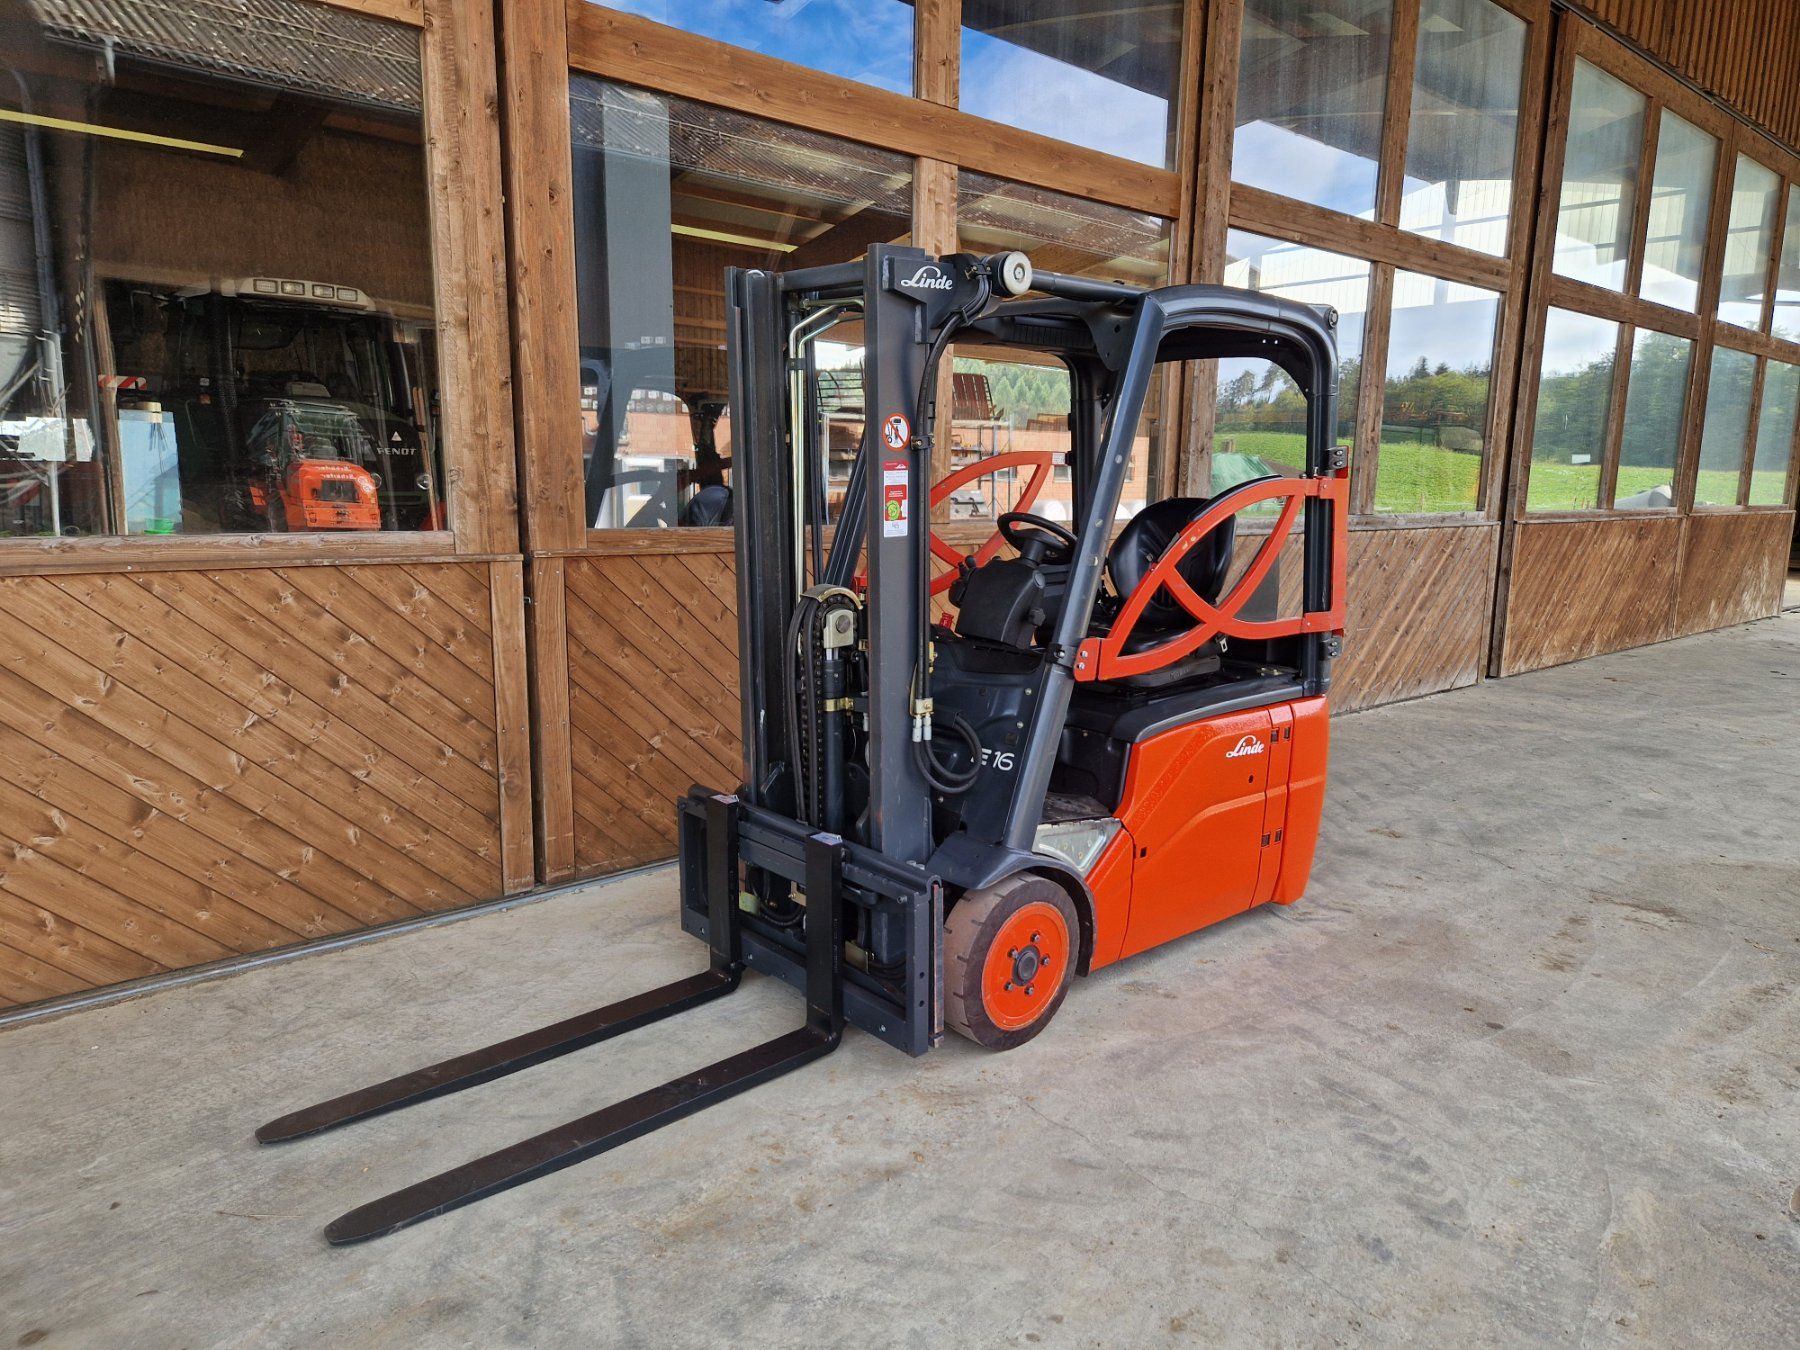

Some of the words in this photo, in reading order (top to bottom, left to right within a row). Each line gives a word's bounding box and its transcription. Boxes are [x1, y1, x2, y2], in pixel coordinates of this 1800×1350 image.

[900, 265, 953, 290] Linde
[376, 446, 417, 456] FENDT
[1225, 734, 1265, 758] Linde
